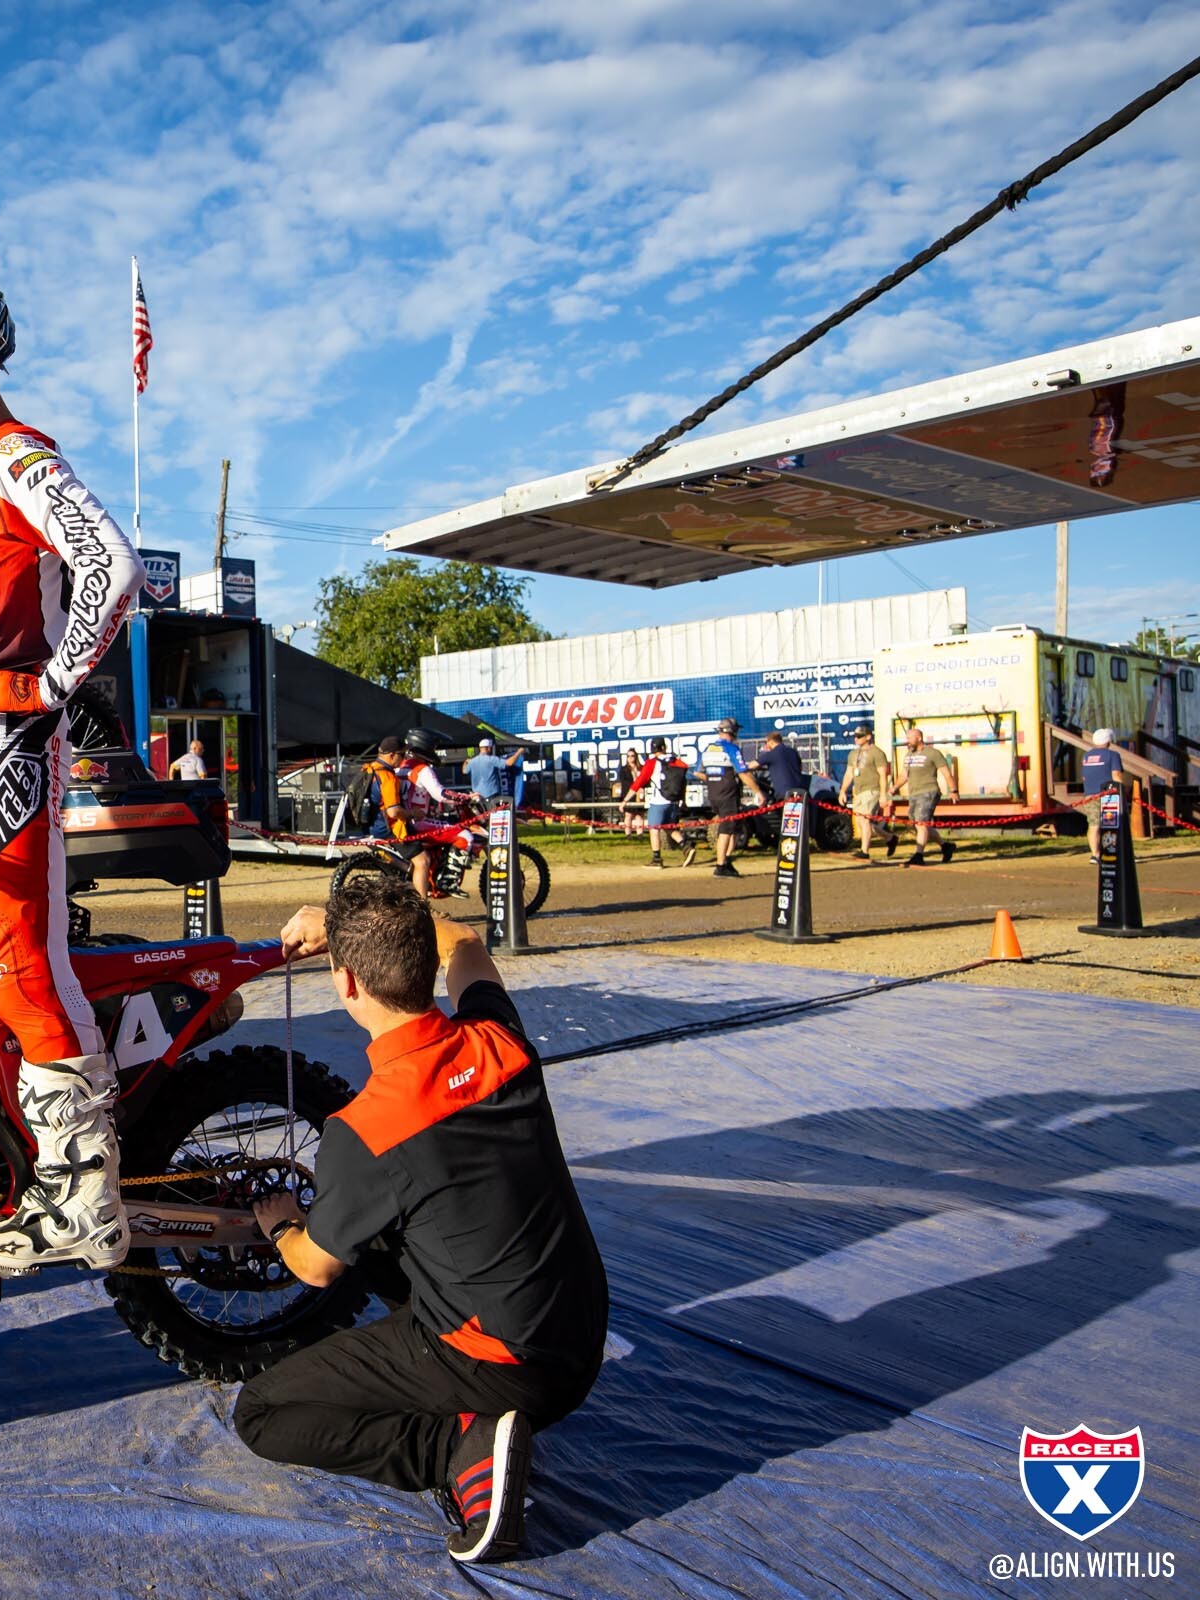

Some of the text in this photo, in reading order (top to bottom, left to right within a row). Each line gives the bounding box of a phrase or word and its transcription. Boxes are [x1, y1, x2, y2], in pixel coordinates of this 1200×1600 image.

[45, 484, 113, 569] Designs
[73, 567, 112, 628] Lee
[756, 682, 806, 697] WATCH
[809, 680, 838, 693] ALL
[834, 691, 875, 706] MAV
[535, 692, 667, 728] LUCAS OIL
[134, 949, 187, 965] GASGAS
[447, 1066, 476, 1091] WP
